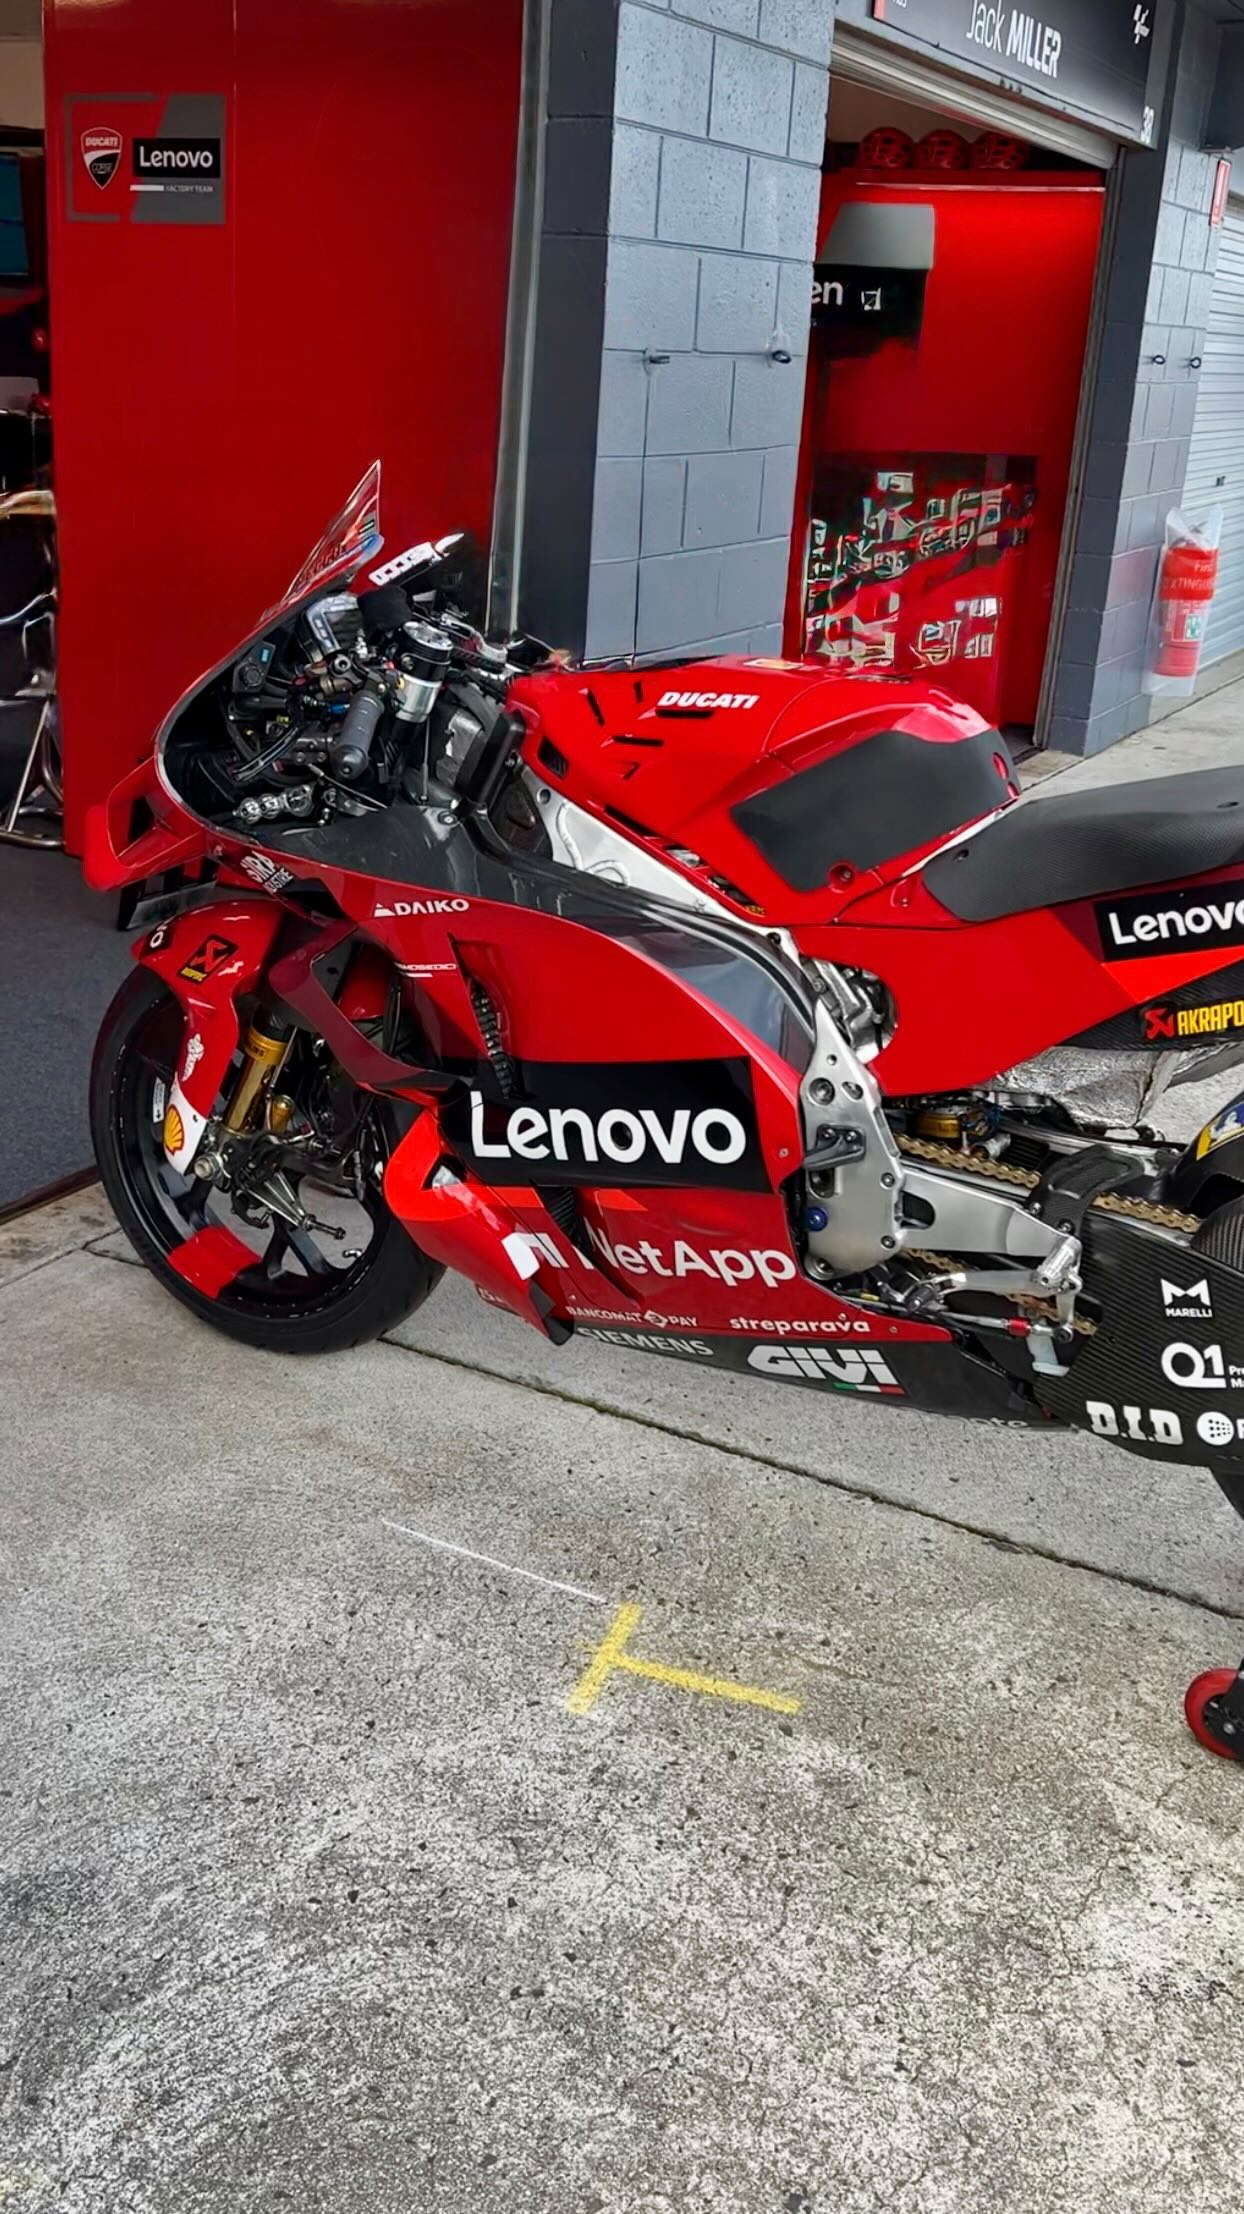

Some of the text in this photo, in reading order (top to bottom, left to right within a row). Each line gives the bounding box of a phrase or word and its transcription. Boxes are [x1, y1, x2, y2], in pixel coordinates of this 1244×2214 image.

[966, 0, 1062, 78] Jack MILLER
[85, 137, 118, 147] DUCATI
[139, 145, 213, 168] Lenovo
[656, 691, 760, 709] DUCATI
[394, 899, 470, 916] DAIKO
[470, 1090, 747, 1165] Lenovo
[572, 1216, 797, 1289] NetApp
[566, 1306, 698, 1328] BANCOMAT PAY
[1165, 1307, 1213, 1318] MARELLI
[729, 1317, 871, 1335] streparava
[576, 1327, 714, 1356] SIEMENS
[747, 1345, 899, 1385] GIVI
[1161, 1342, 1227, 1389] Q1
